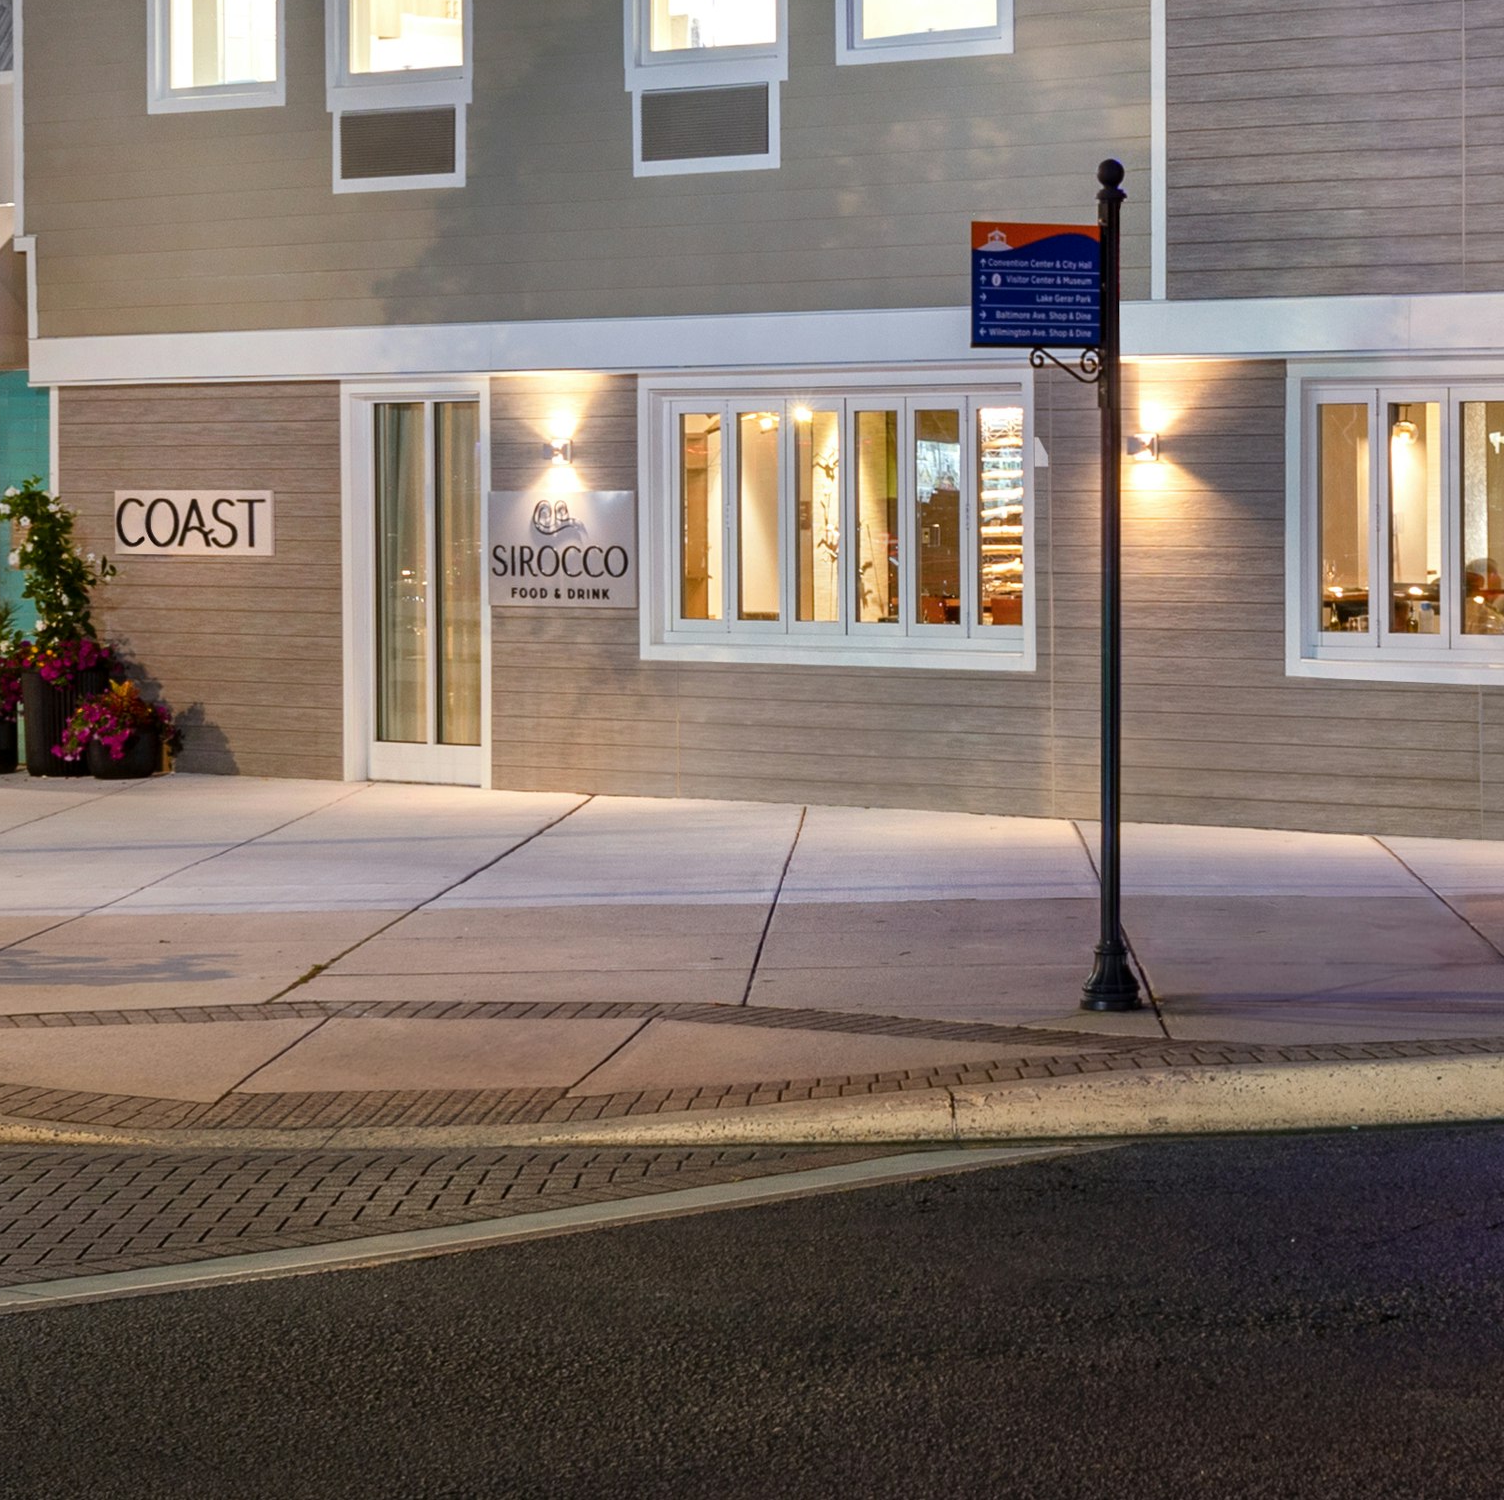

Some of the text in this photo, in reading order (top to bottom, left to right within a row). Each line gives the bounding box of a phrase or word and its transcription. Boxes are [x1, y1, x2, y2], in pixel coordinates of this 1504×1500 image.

[987, 258, 1092, 270] Convention Center & City Hall
[1006, 275, 1092, 285] Visitor Center & Museum
[1036, 294, 1053, 303] Lake
[1075, 294, 1091, 303] Park
[995, 310, 1031, 319] Baltimore
[1049, 311, 1067, 321] Shop
[1069, 311, 1074, 320] &
[1075, 311, 1092, 320] Dine
[989, 327, 1031, 338] Wilmington
[1049, 328, 1067, 338] Shop
[1069, 328, 1074, 337] &
[1075, 328, 1092, 338] Dine
[116, 497, 266, 548] COAST
[492, 545, 629, 578] SIROCCO
[511, 587, 610, 600] FOOD & DRINK
